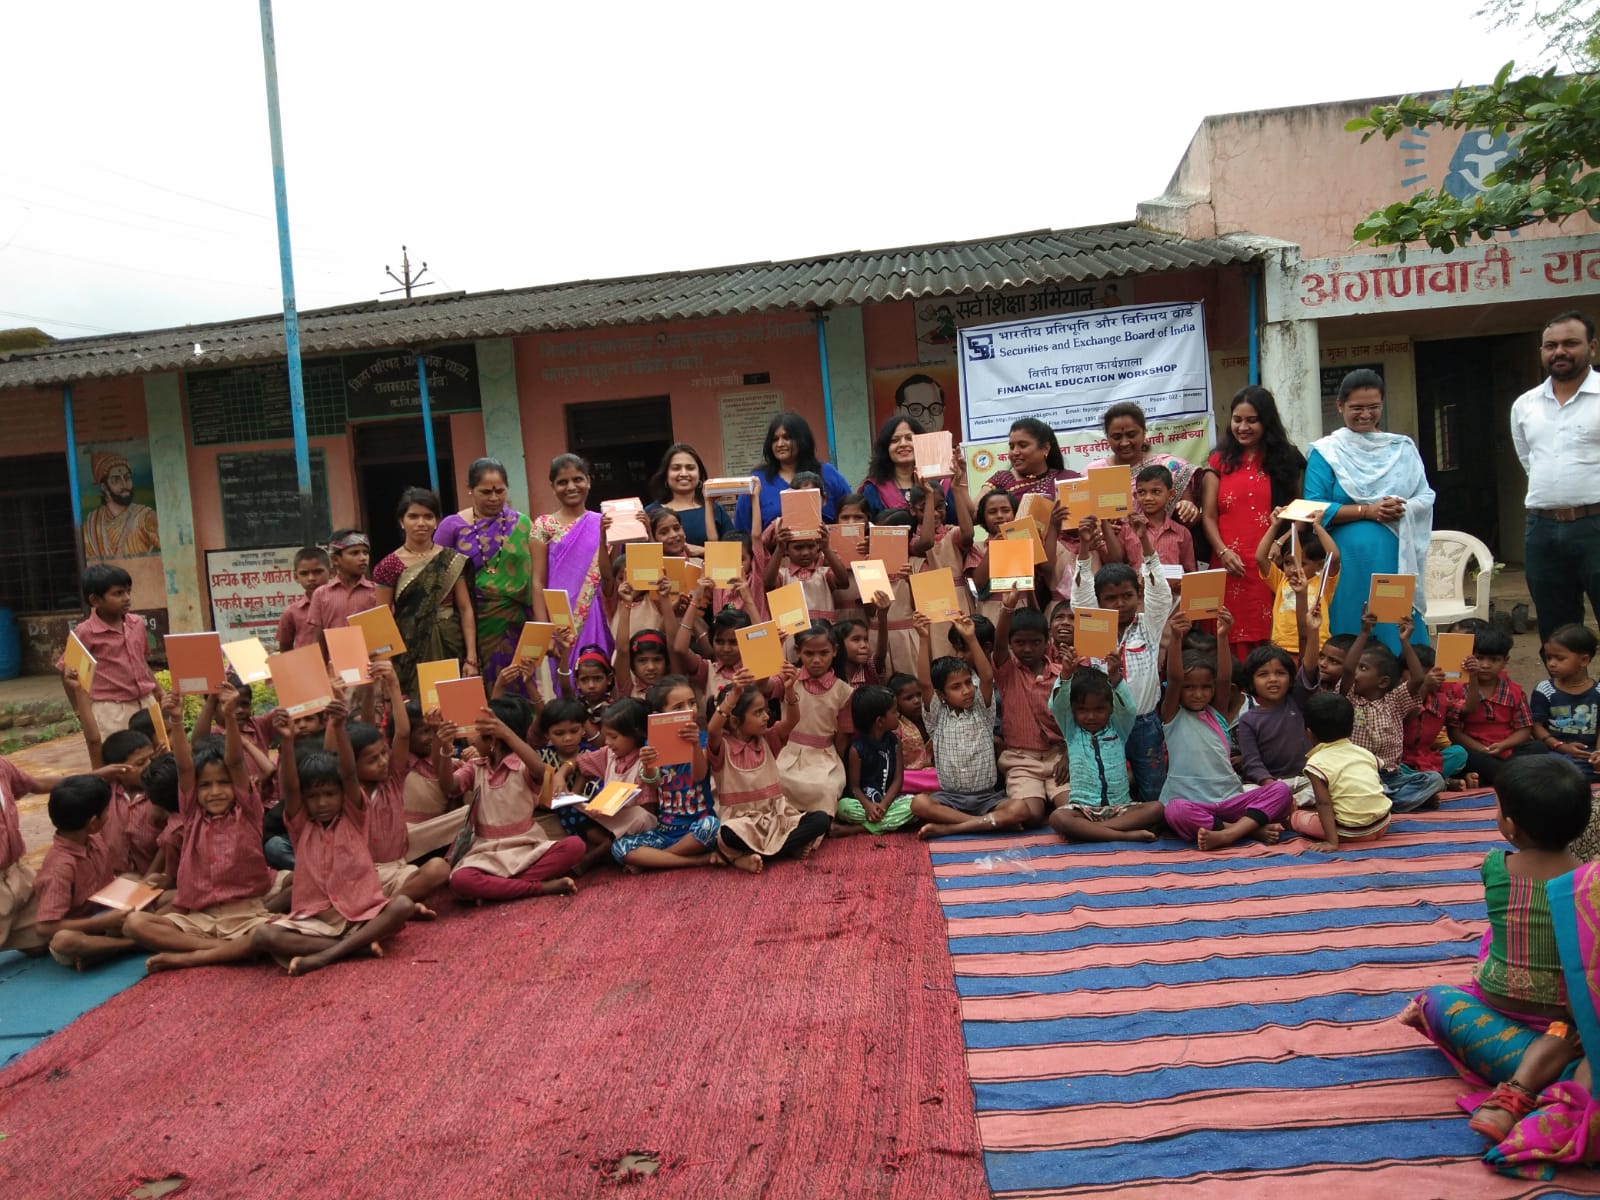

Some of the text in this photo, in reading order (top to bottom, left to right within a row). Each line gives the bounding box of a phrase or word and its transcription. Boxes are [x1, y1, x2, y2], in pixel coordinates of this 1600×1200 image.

[999, 326, 1042, 342] भारतीय
[1046, 320, 1090, 336] प्रतिभूति
[1095, 315, 1118, 329] और
[1122, 310, 1168, 326] विनिमय
[999, 323, 1196, 358] Securities and Exchange Board of India
[997, 364, 1178, 395] FINANCIAL EDUCATION WORKSHOP
[1028, 356, 1143, 379] वित्तीय शिक्षण कार्यशाला
